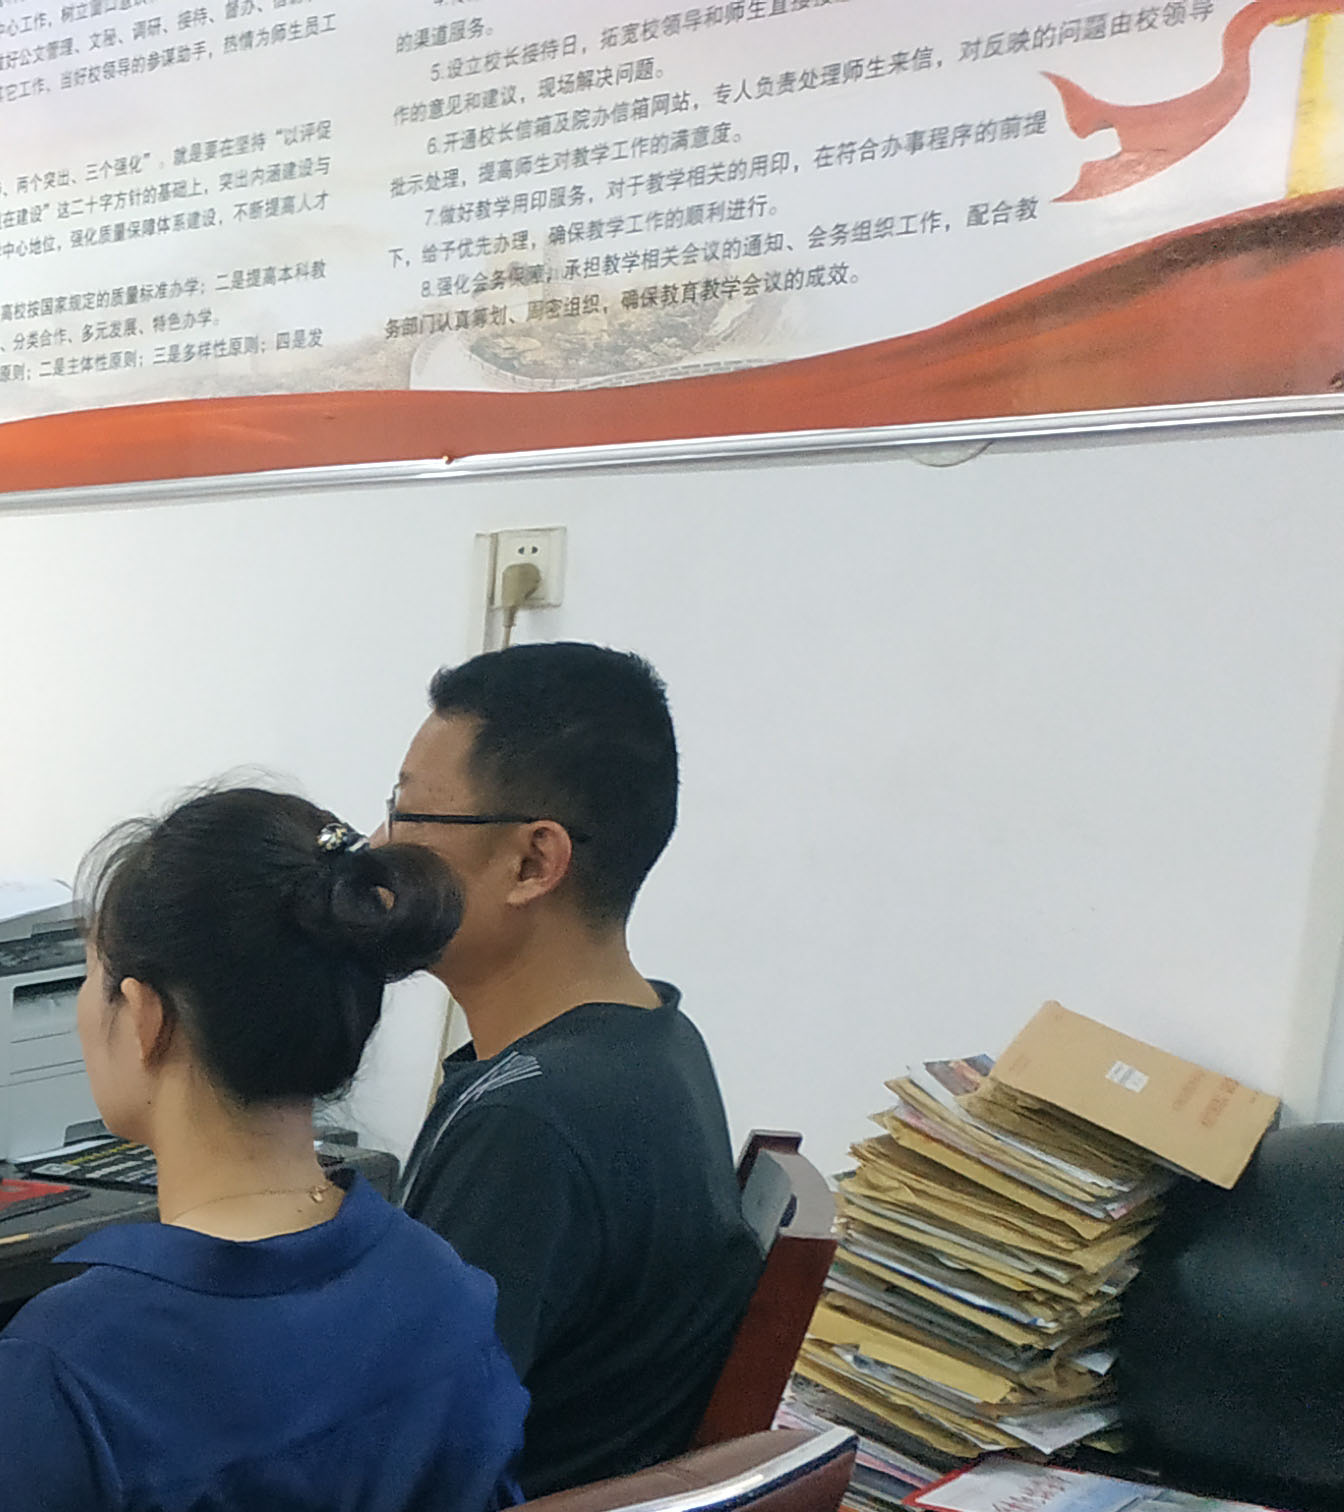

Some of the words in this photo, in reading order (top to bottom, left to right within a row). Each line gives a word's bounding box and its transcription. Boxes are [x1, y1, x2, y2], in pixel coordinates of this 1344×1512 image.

[396, 17, 494, 54] 的渠道服务。
